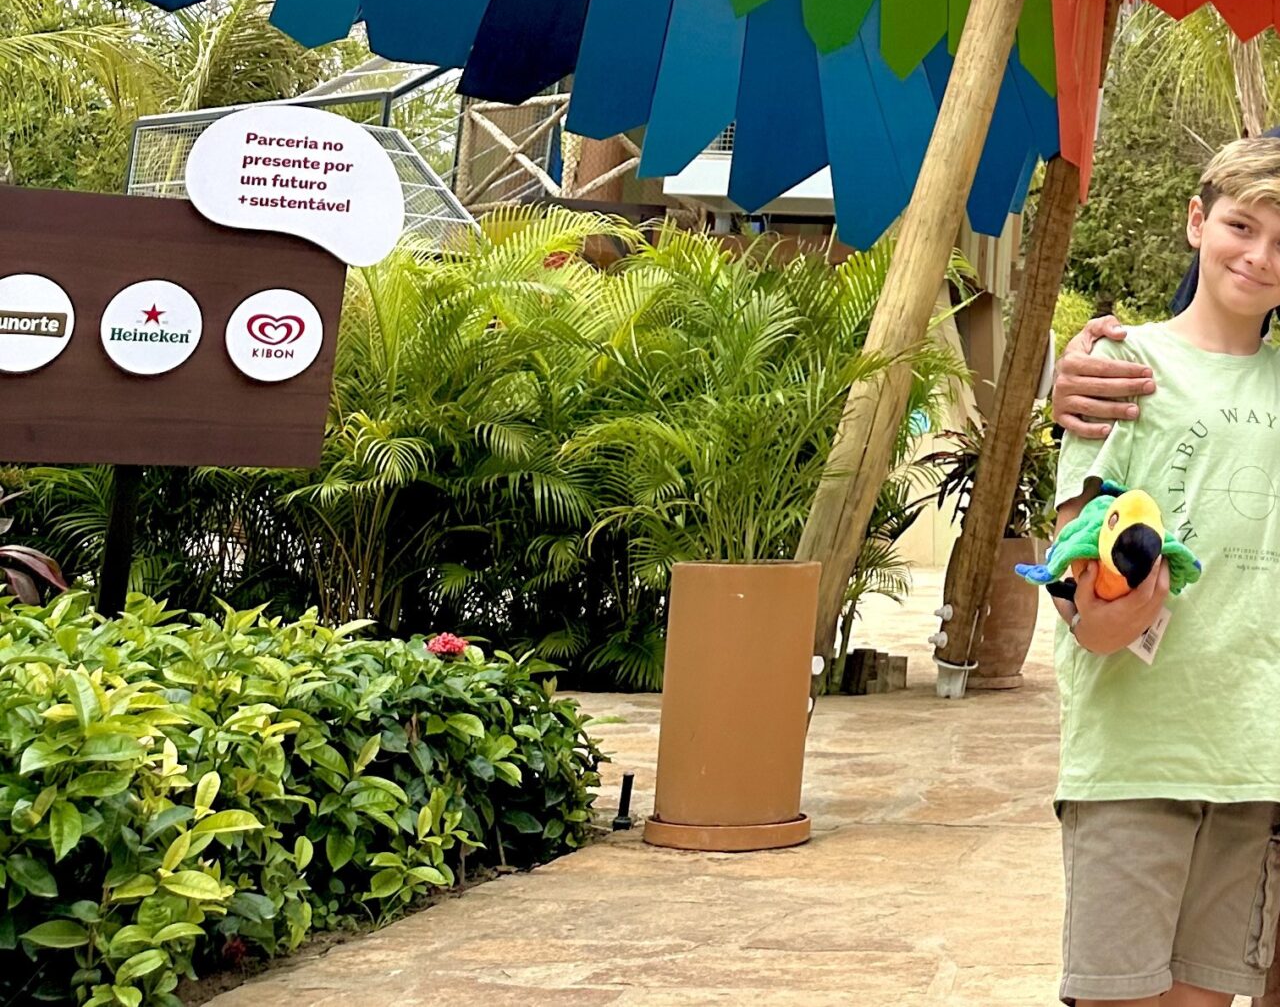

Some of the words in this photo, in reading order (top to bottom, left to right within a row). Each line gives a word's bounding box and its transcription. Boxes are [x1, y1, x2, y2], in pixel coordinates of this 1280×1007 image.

[245, 132, 318, 150] Parceria
[322, 141, 344, 152] no
[242, 155, 320, 169] presente
[323, 161, 354, 175] por
[240, 175, 267, 186] um
[272, 174, 327, 191] futuro
[238, 194, 350, 213] +sustentável
[110, 327, 190, 343] Heineken
[252, 348, 294, 359] KIBON
[1168, 419, 1209, 544] MALIBU
[1220, 408, 1277, 429] WAY
